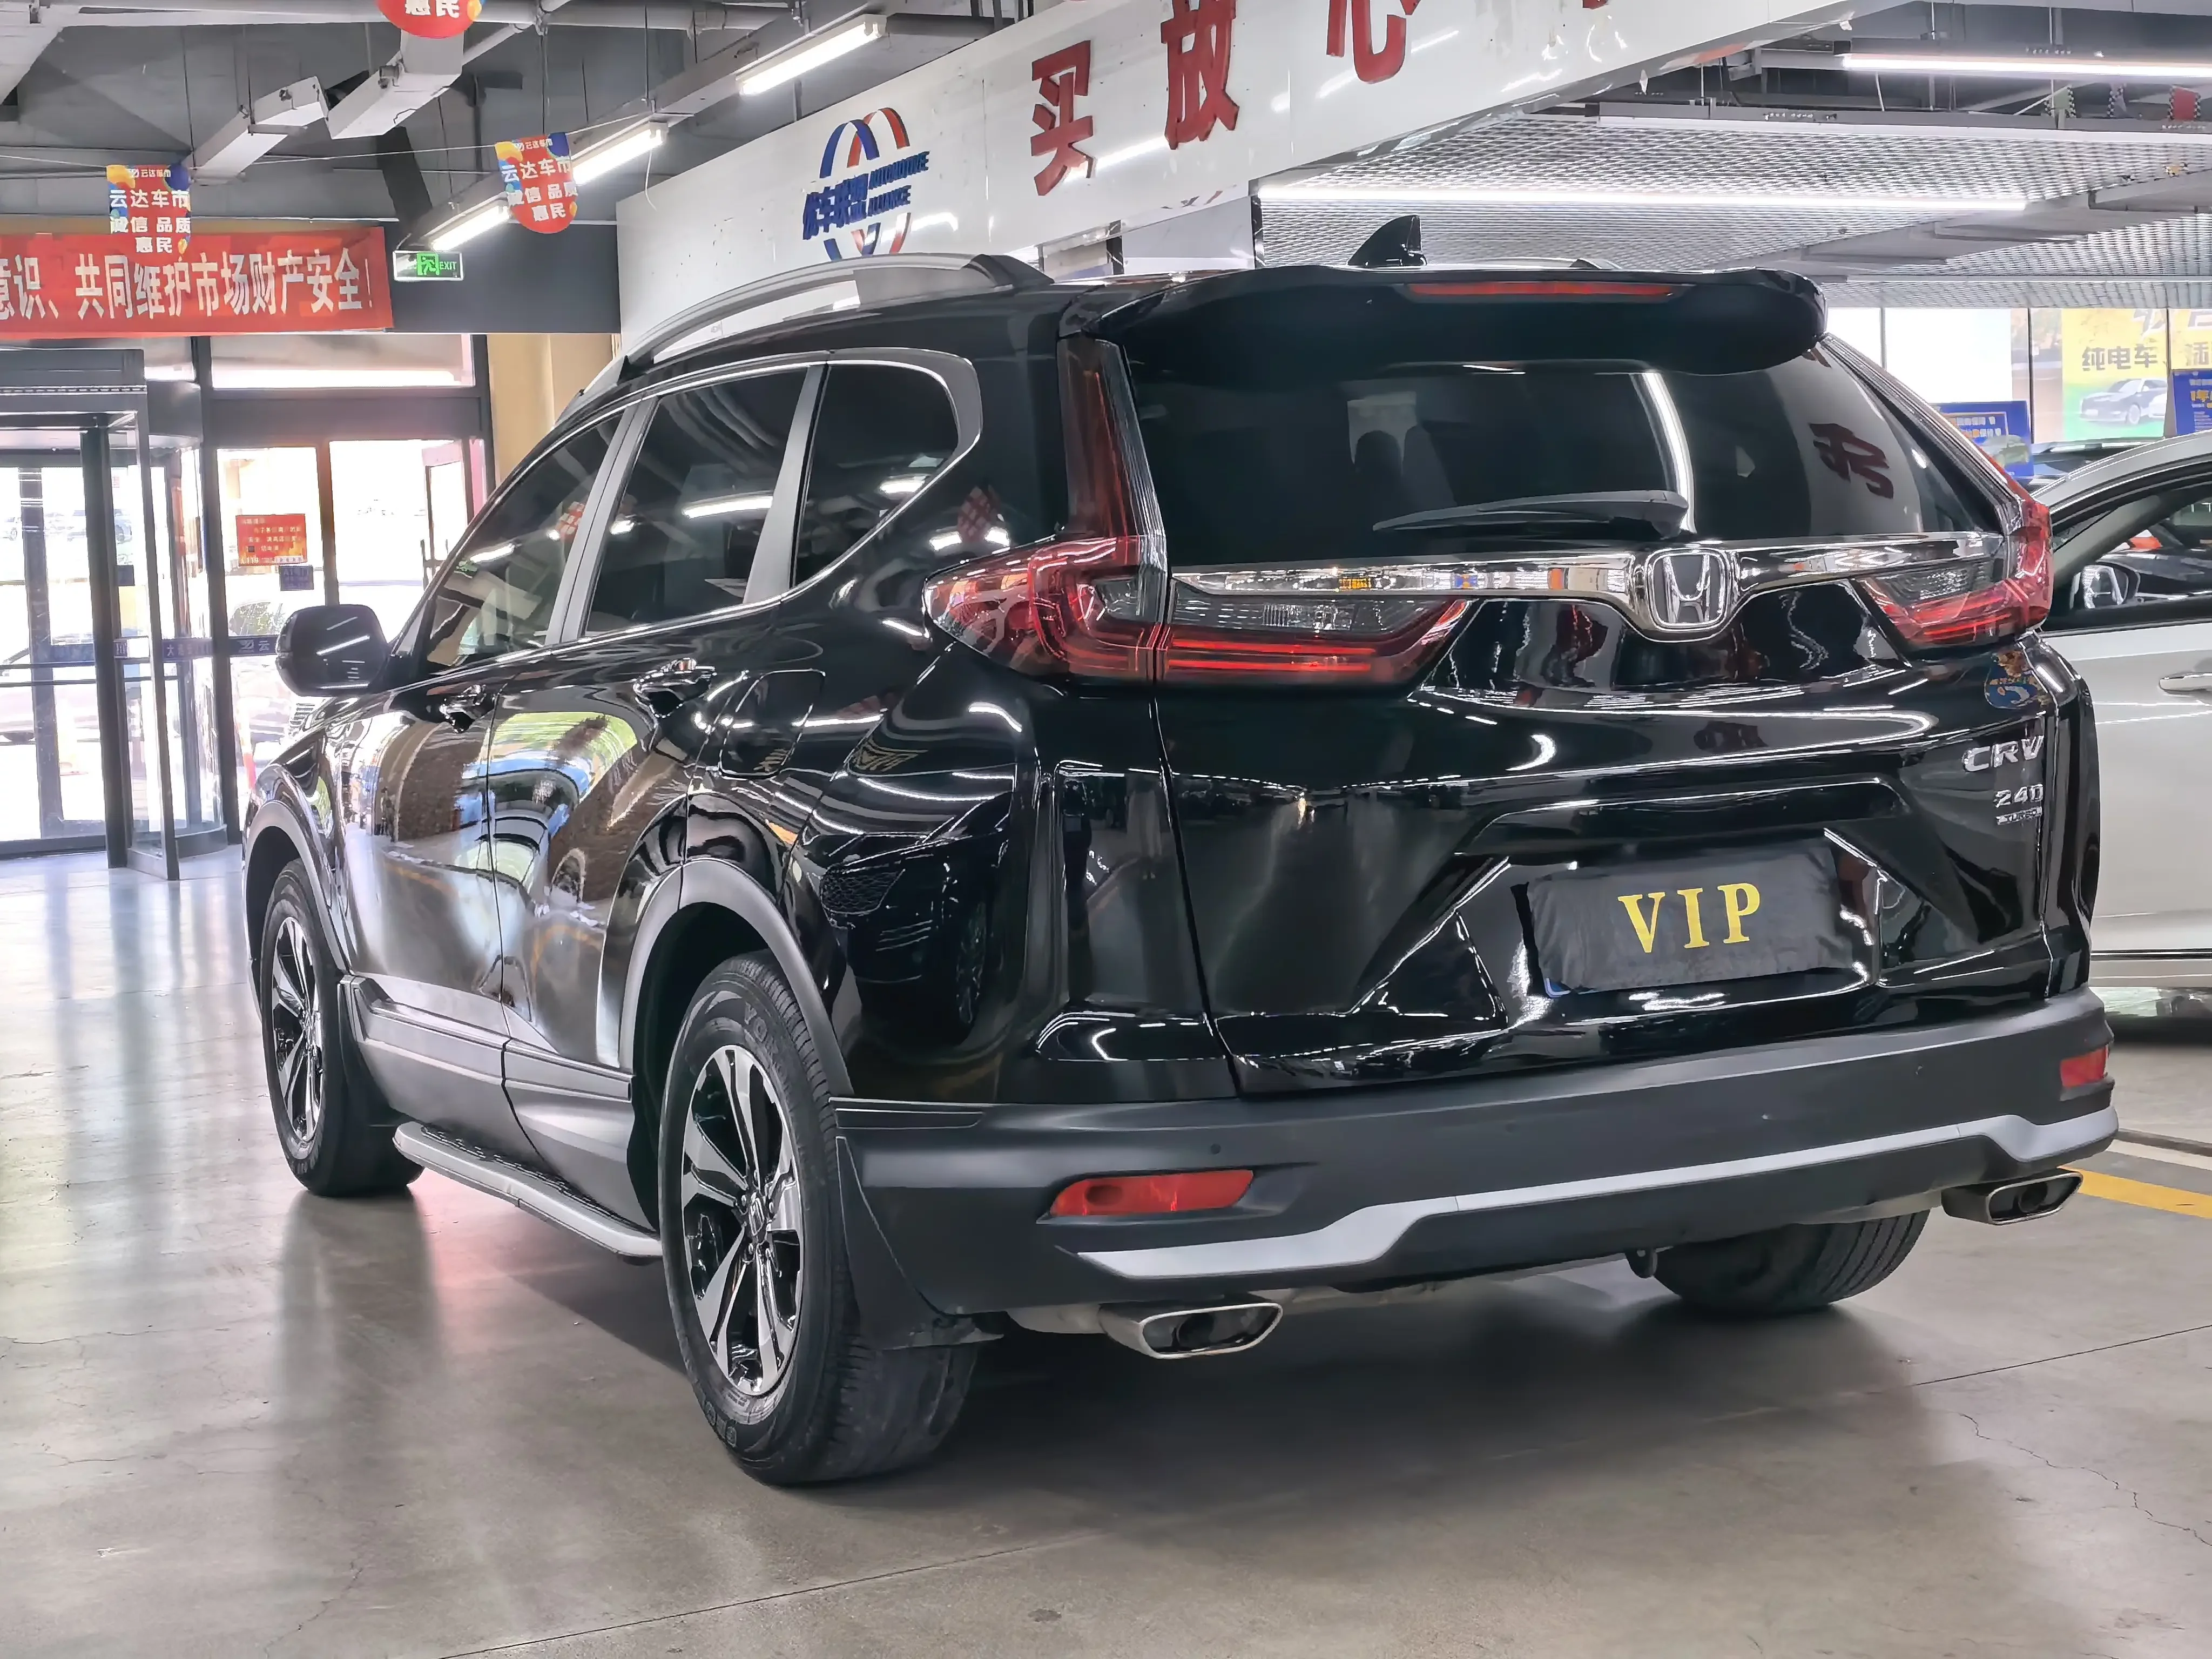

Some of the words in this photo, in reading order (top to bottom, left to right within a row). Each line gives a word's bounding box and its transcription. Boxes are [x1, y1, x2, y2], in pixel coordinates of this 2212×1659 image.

[501, 156, 571, 183] 云达车市
[109, 189, 191, 210] 云达车市
[439, 261, 457, 270] EXIT
[2082, 343, 2158, 372] 纯电车
[1617, 882, 1761, 953] VIP
